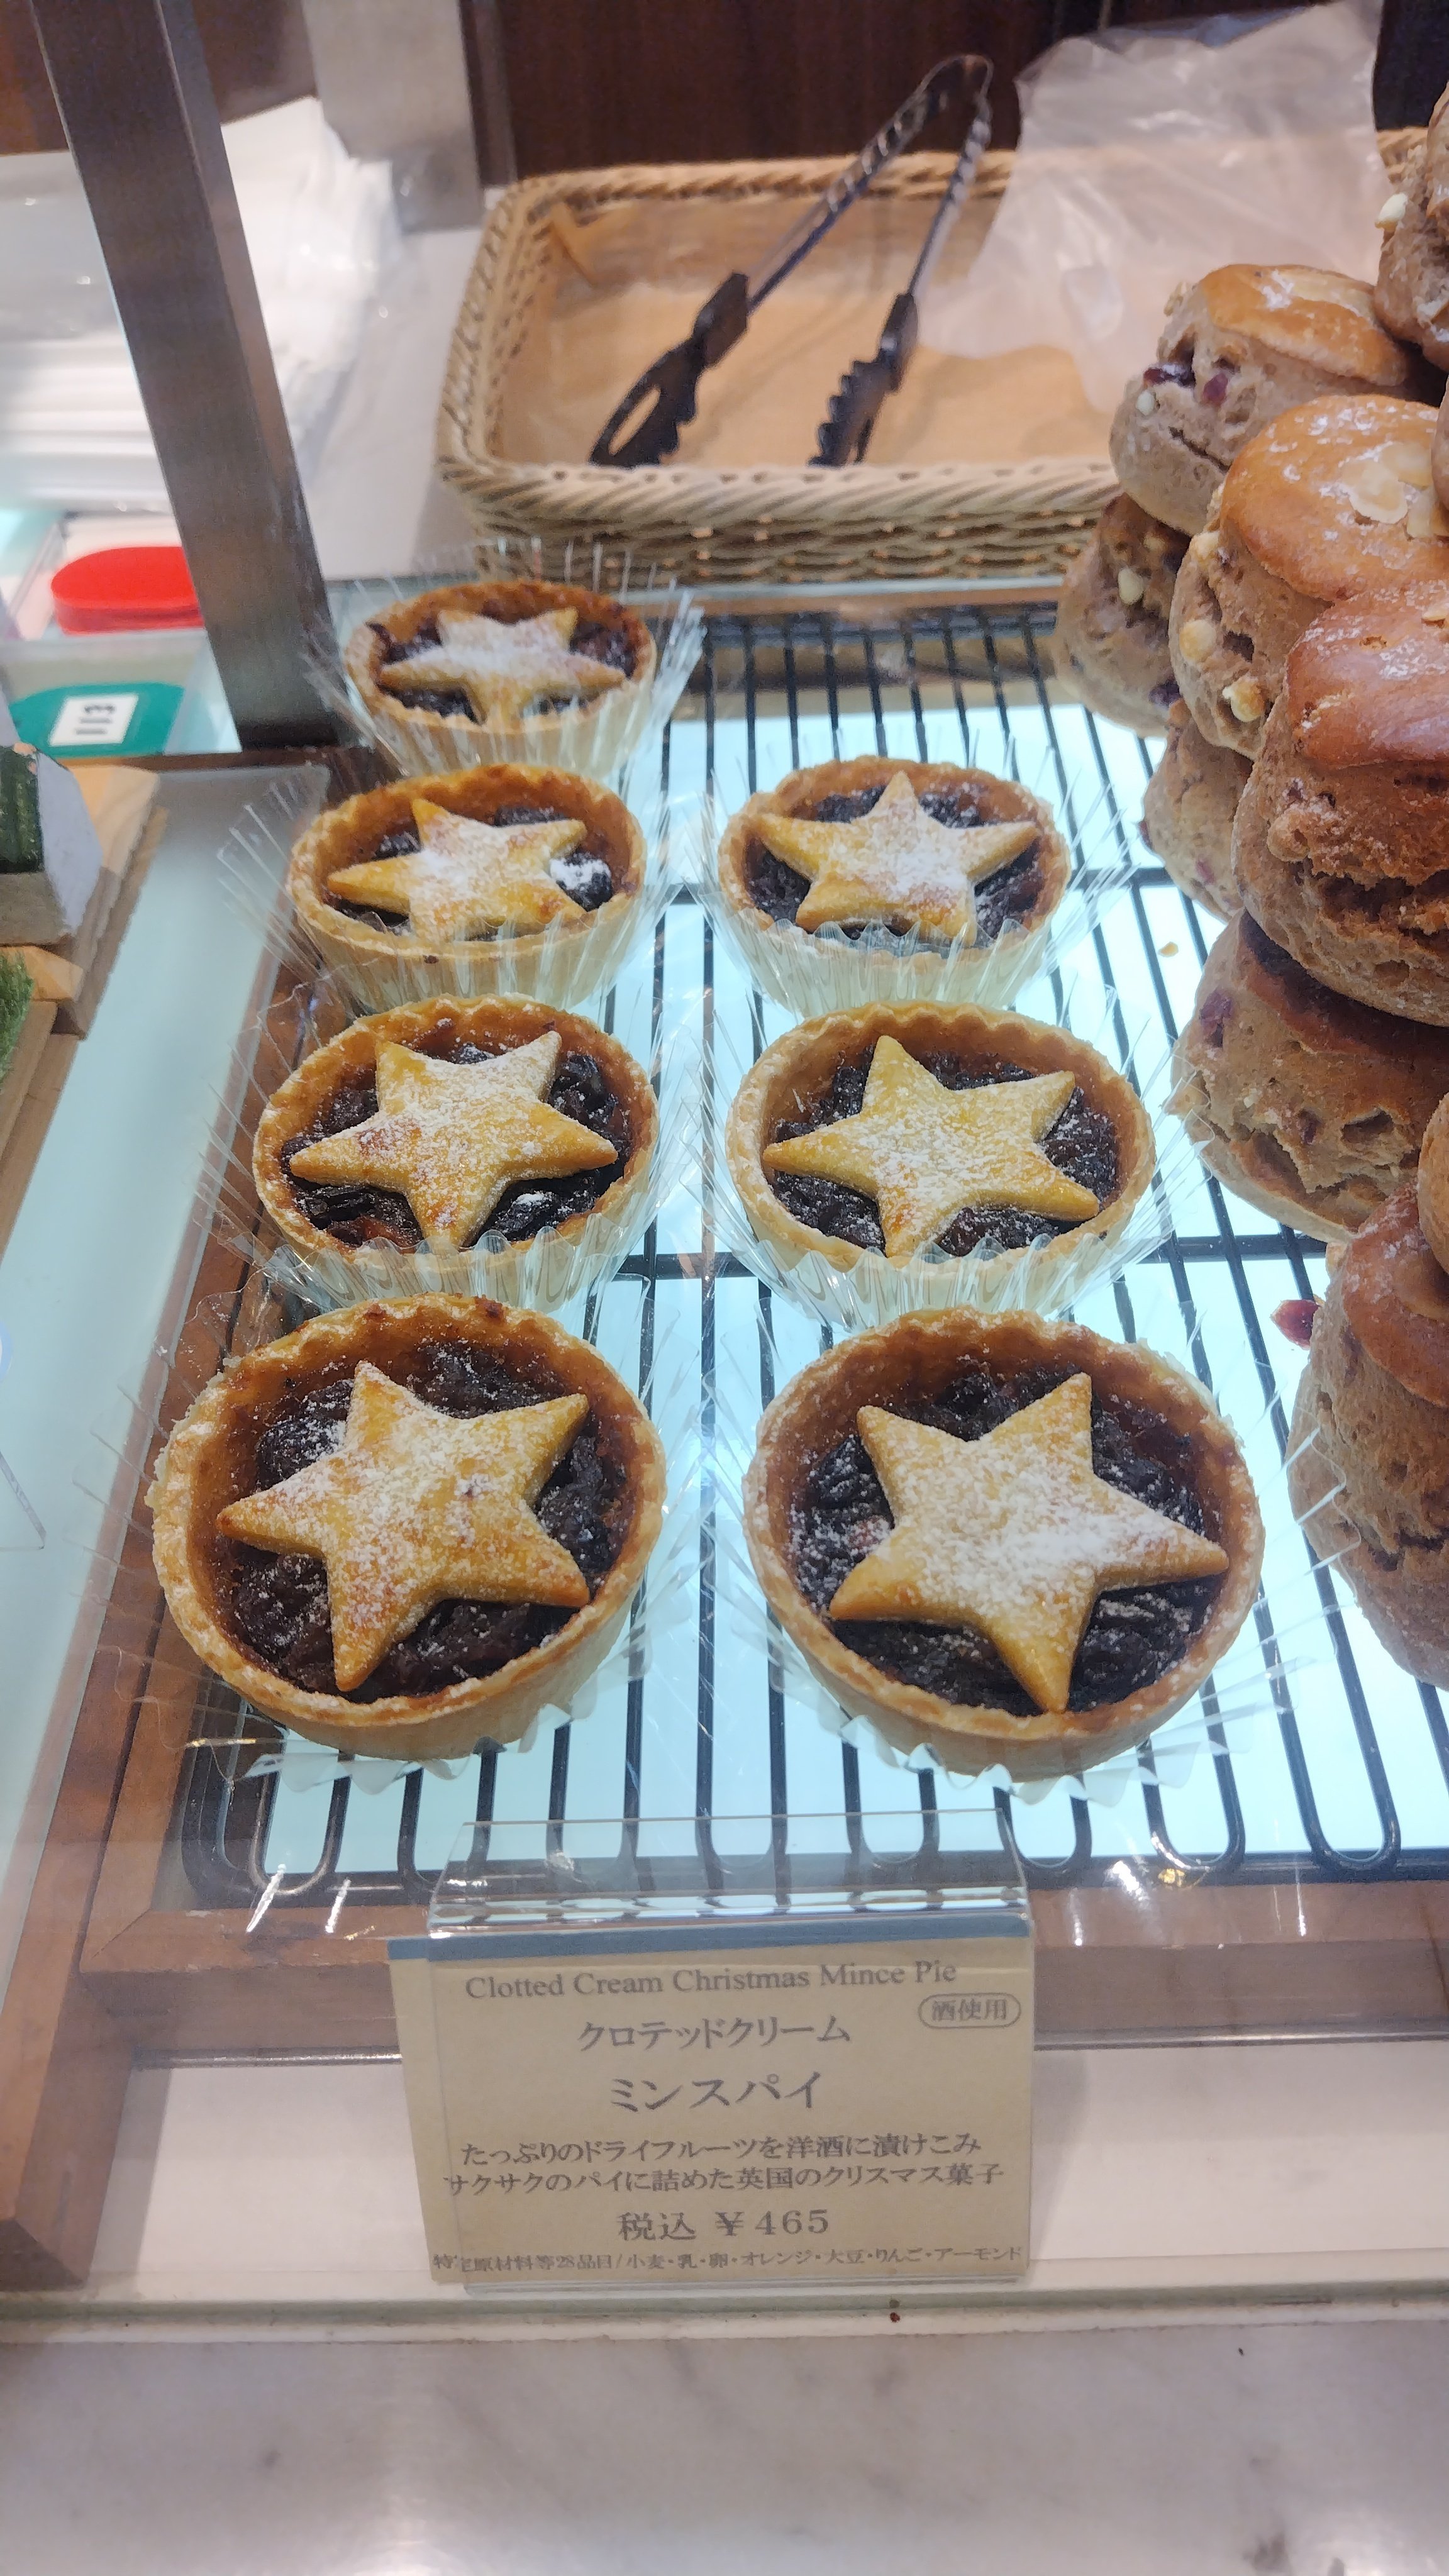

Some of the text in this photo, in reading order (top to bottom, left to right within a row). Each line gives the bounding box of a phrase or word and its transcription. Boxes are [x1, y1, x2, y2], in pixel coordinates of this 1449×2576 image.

[465, 1959, 957, 1999] Clotted Cream Christmas Mince Pie
[931, 1998, 1008, 2021] 酒使用
[577, 2014, 851, 2052] クロテッドクリーム
[610, 2071, 821, 2112] ミンスパイ
[461, 2133, 982, 2166] たっぷりのドライフルーツを洋酒に漬けこみ
[443, 2162, 1004, 2196] サクサクのパイに詰めた英国のクリスマス菓子
[617, 2211, 697, 2241] 税込
